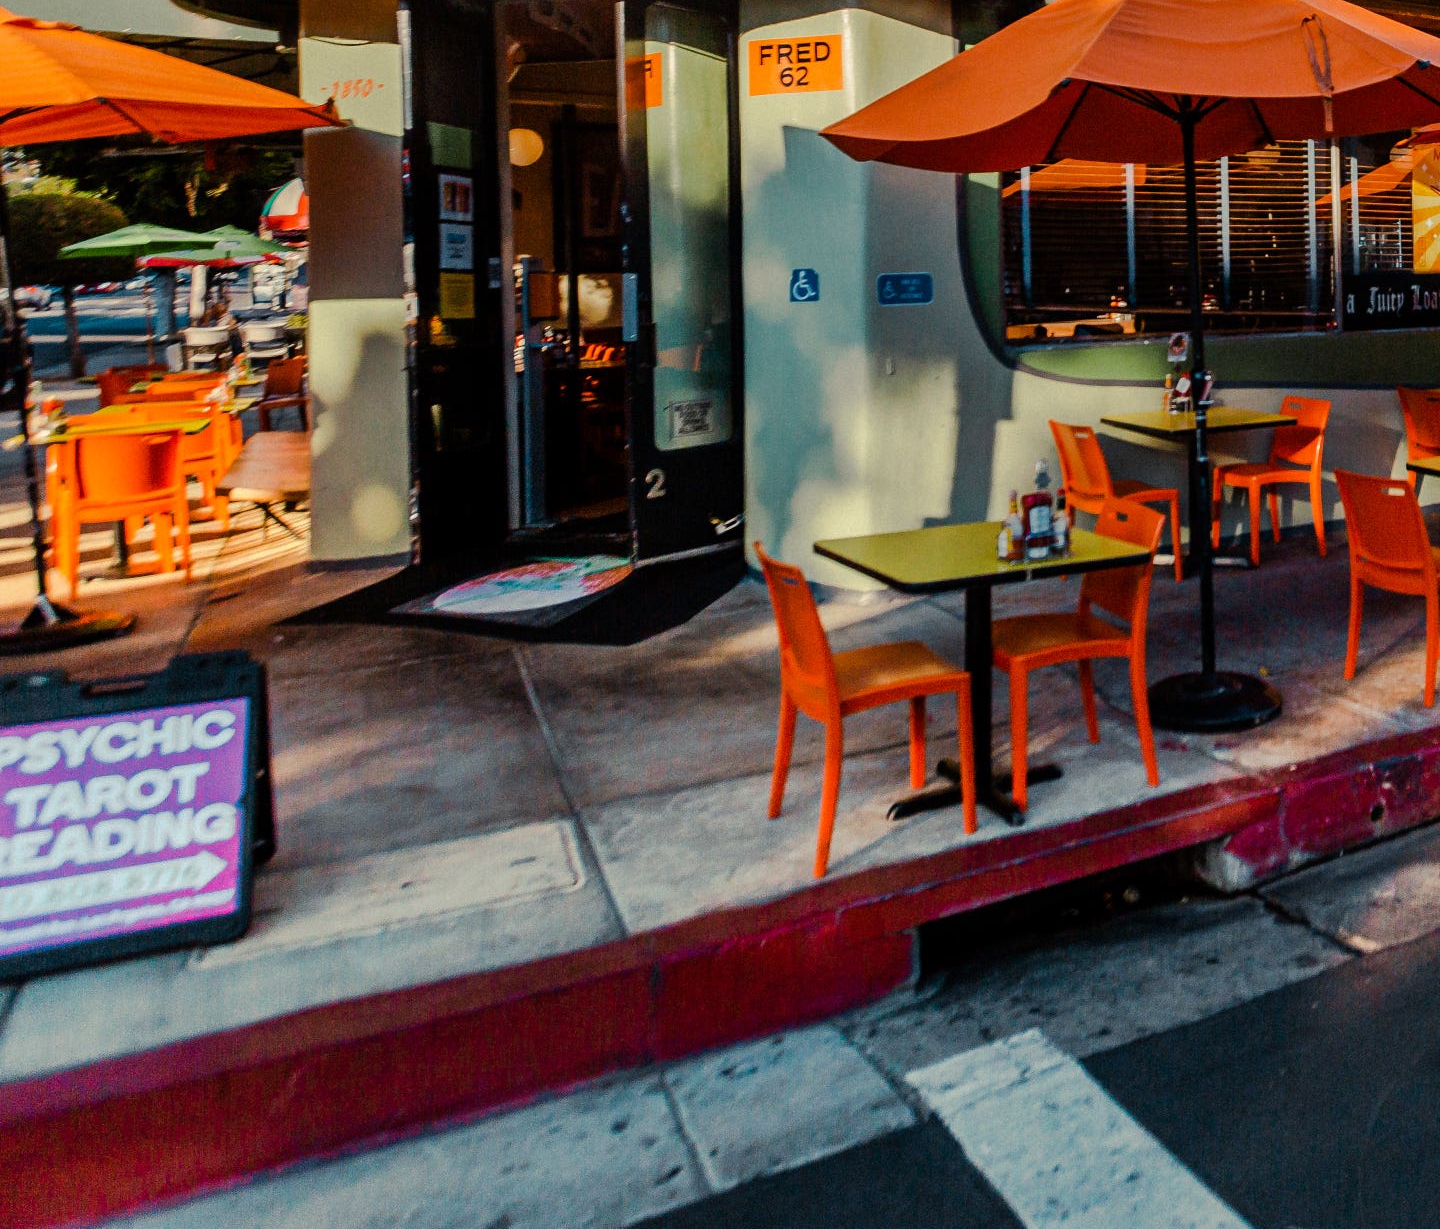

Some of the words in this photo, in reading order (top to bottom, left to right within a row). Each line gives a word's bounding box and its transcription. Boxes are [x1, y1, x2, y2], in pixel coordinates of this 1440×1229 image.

[759, 41, 831, 66] FRED
[780, 65, 810, 88] 62
[1346, 293, 1355, 313] a
[1367, 286, 1405, 315] Juicy
[645, 468, 667, 499] 2
[0, 709, 236, 774] PSYCHIC
[4, 762, 210, 828] TAROT
